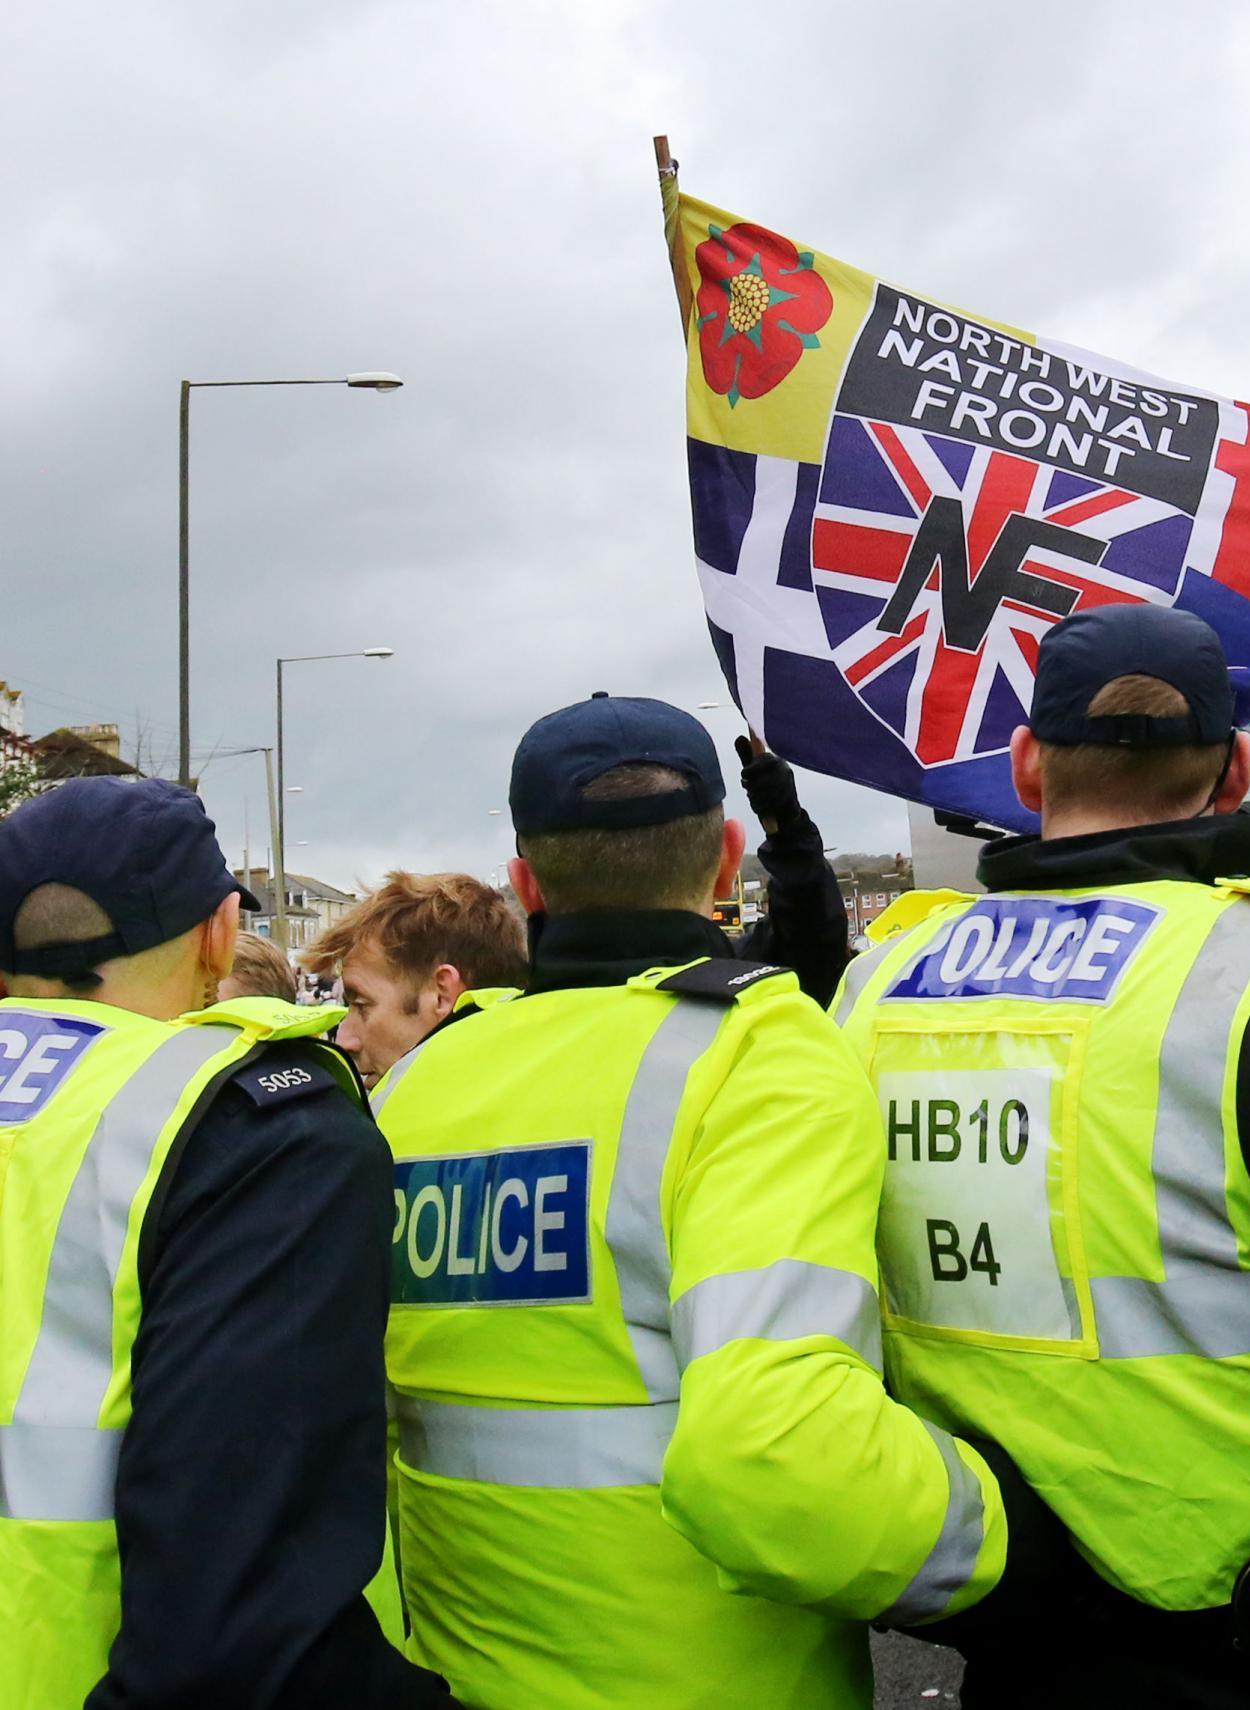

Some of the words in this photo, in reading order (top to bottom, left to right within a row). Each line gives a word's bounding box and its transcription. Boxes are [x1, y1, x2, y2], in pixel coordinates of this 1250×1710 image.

[877, 329, 1192, 462] NATIONAL
[893, 298, 1051, 379] NORTH
[1066, 361, 1199, 425] WEST
[910, 380, 1137, 476] FRONT
[876, 495, 1112, 655] NF
[258, 1068, 312, 1093] 5053
[888, 1099, 1030, 1166] HB10
[926, 1218, 1001, 1287] B4
